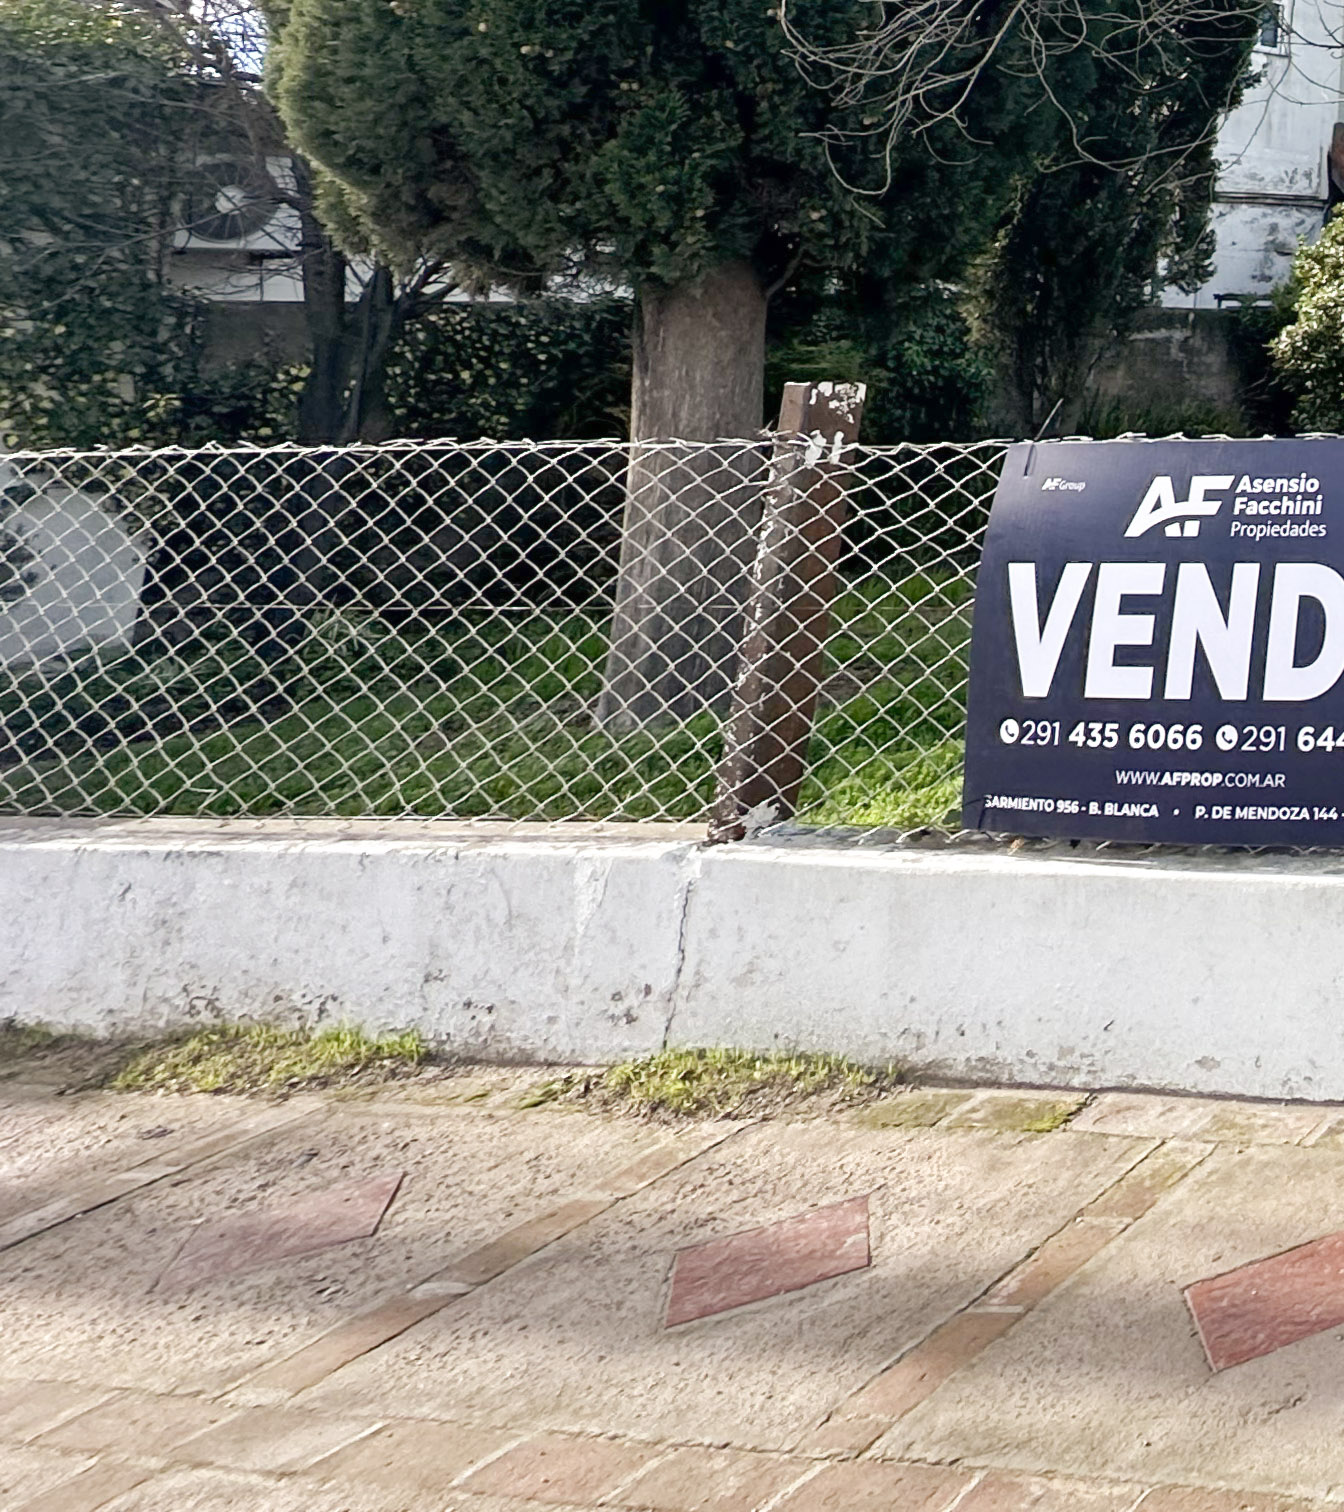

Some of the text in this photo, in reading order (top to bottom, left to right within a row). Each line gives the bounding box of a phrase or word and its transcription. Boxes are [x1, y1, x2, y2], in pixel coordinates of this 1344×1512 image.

[1235, 473, 1320, 494] Asensio
[1123, 474, 1235, 538] AF
[1233, 495, 1323, 516] Facchini
[1230, 520, 1327, 540] Propiedades
[1020, 720, 1203, 750] 291 435 6066
[1240, 724, 1286, 751] 291
[1115, 769, 1286, 788] WWW.AFPROP.COM.AR
[1056, 799, 1080, 813] 956
[1088, 801, 1102, 815] B.
[1104, 802, 1159, 817] BLANCA
[1194, 805, 1209, 819] P.
[1211, 806, 1232, 820] DE
[1235, 806, 1310, 820] MENDOZA
[1313, 806, 1338, 820] 144
